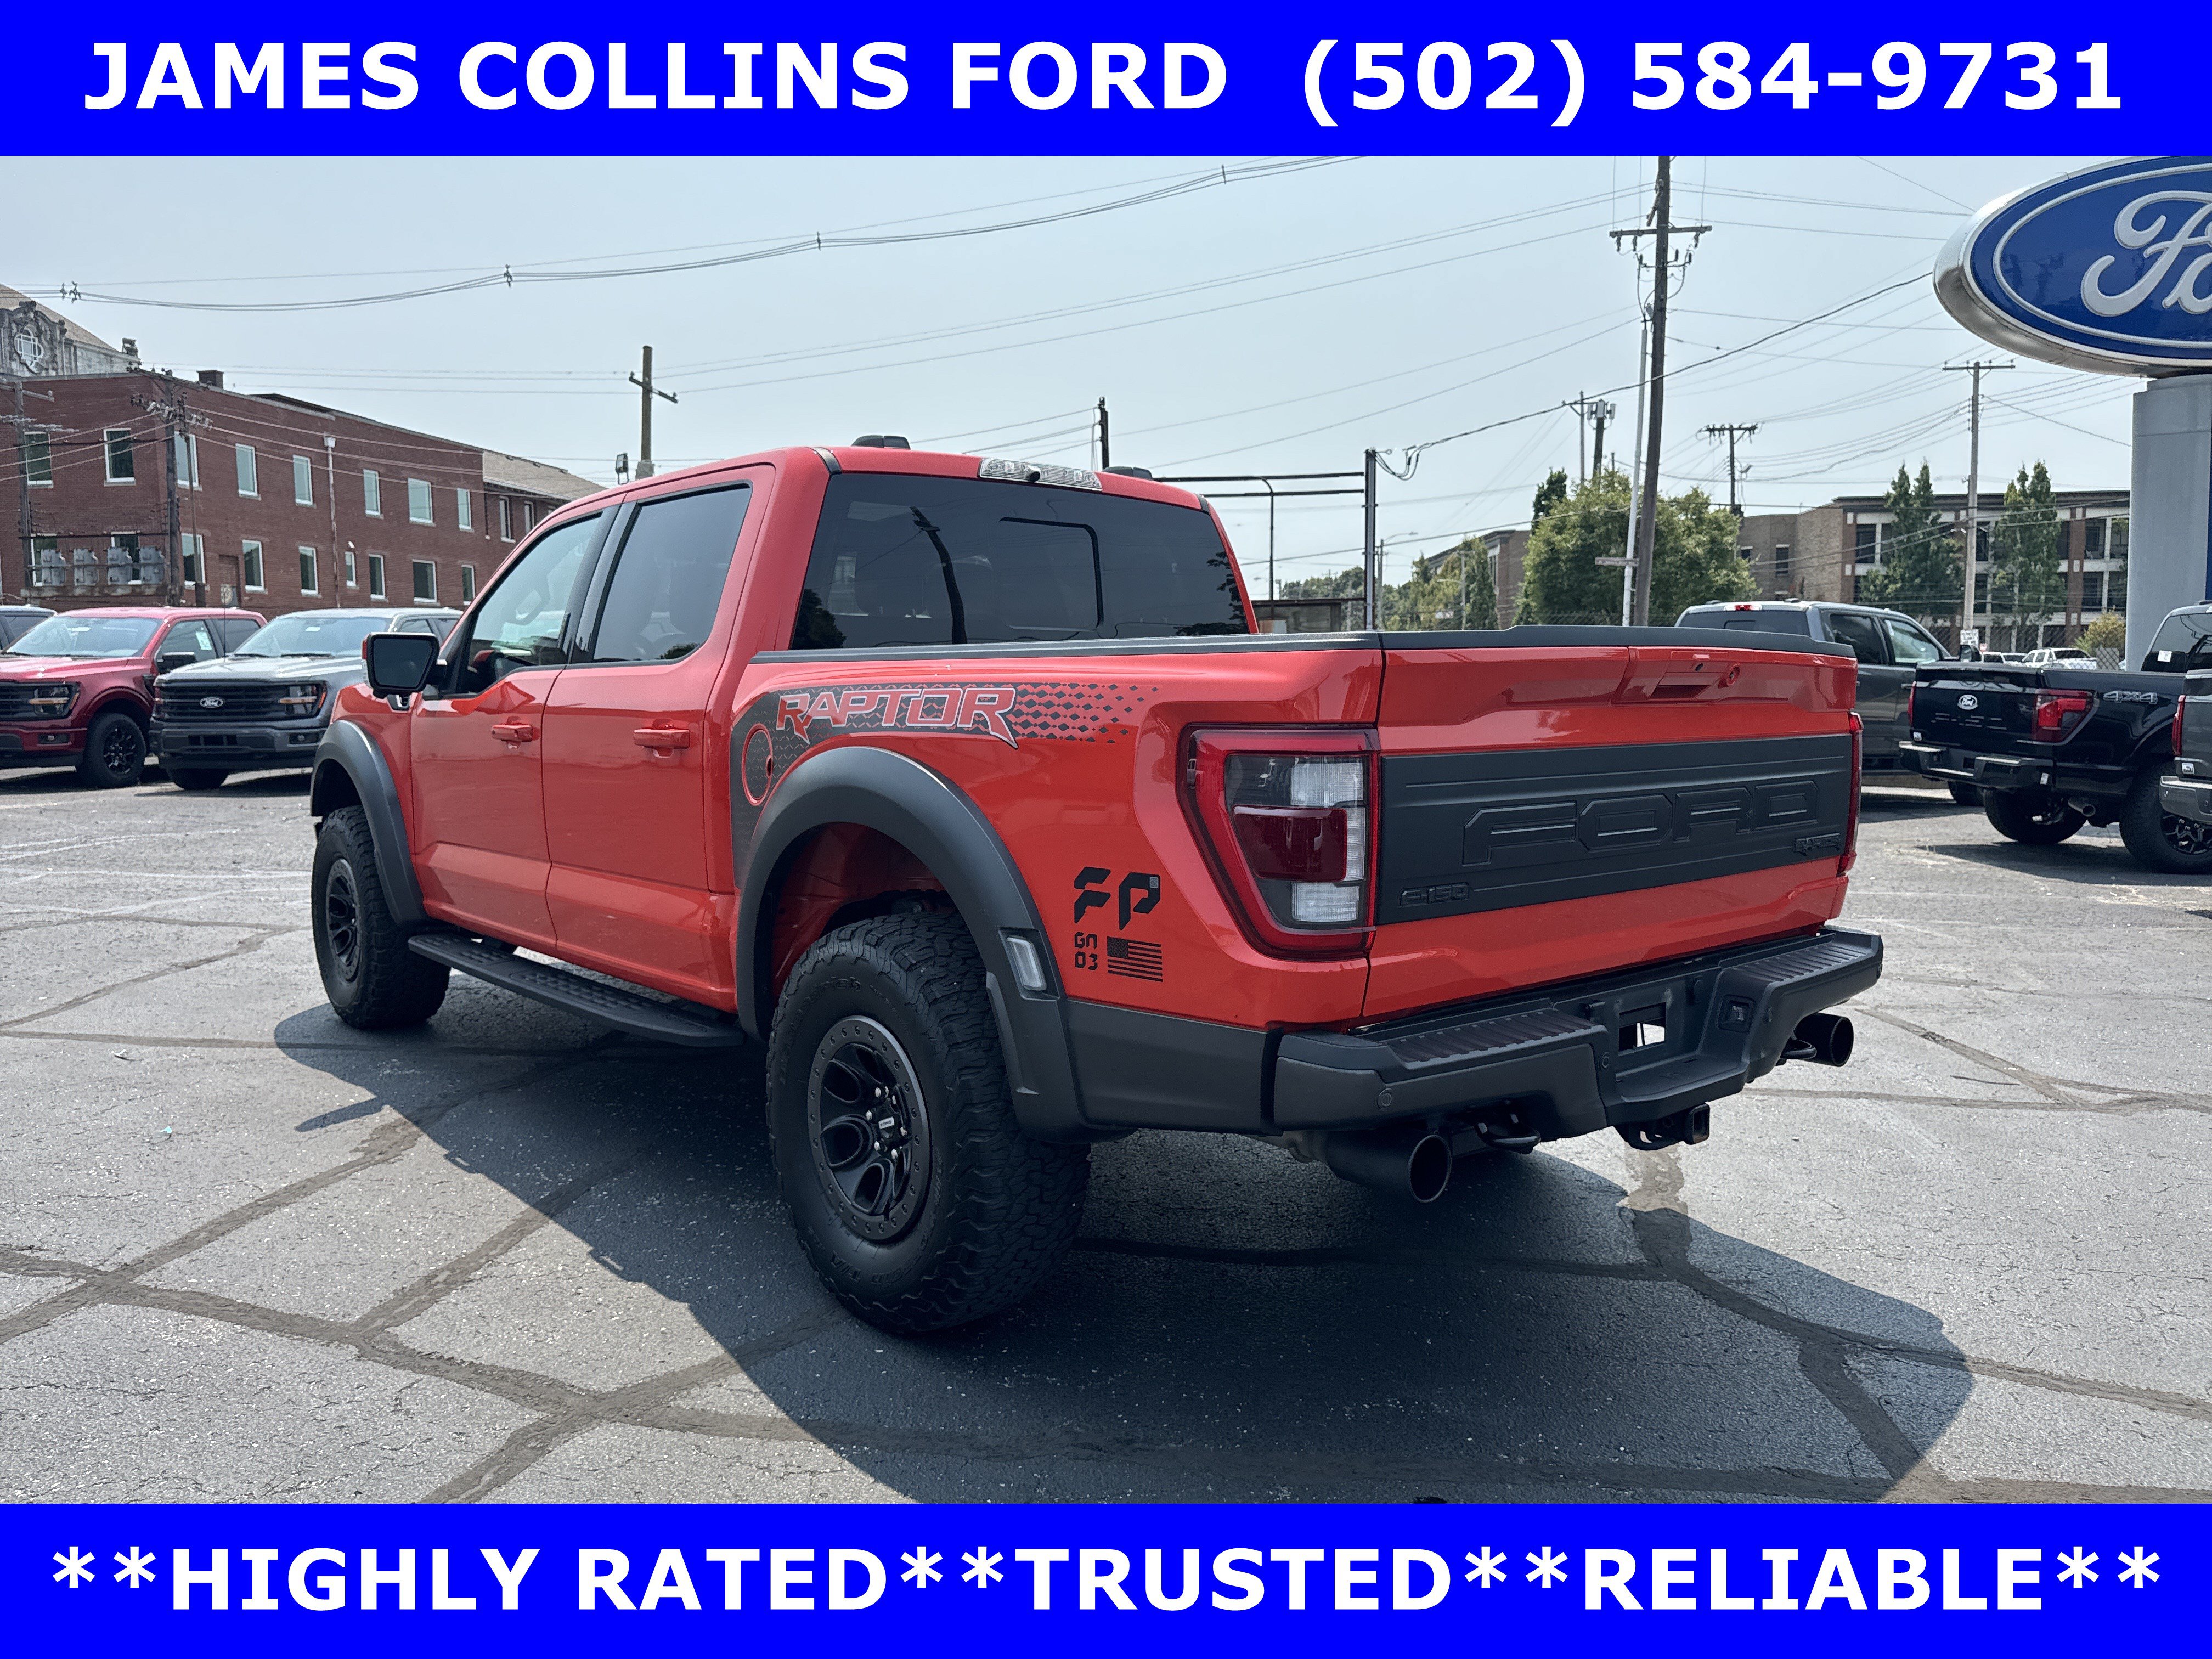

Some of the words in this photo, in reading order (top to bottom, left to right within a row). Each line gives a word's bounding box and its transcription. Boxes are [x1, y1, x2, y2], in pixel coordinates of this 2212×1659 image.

[776, 687, 1018, 749] RAPTOR
[1462, 781, 1819, 866] FORD
[1074, 866, 1160, 931] FP
[1400, 882, 1470, 907] F-150
